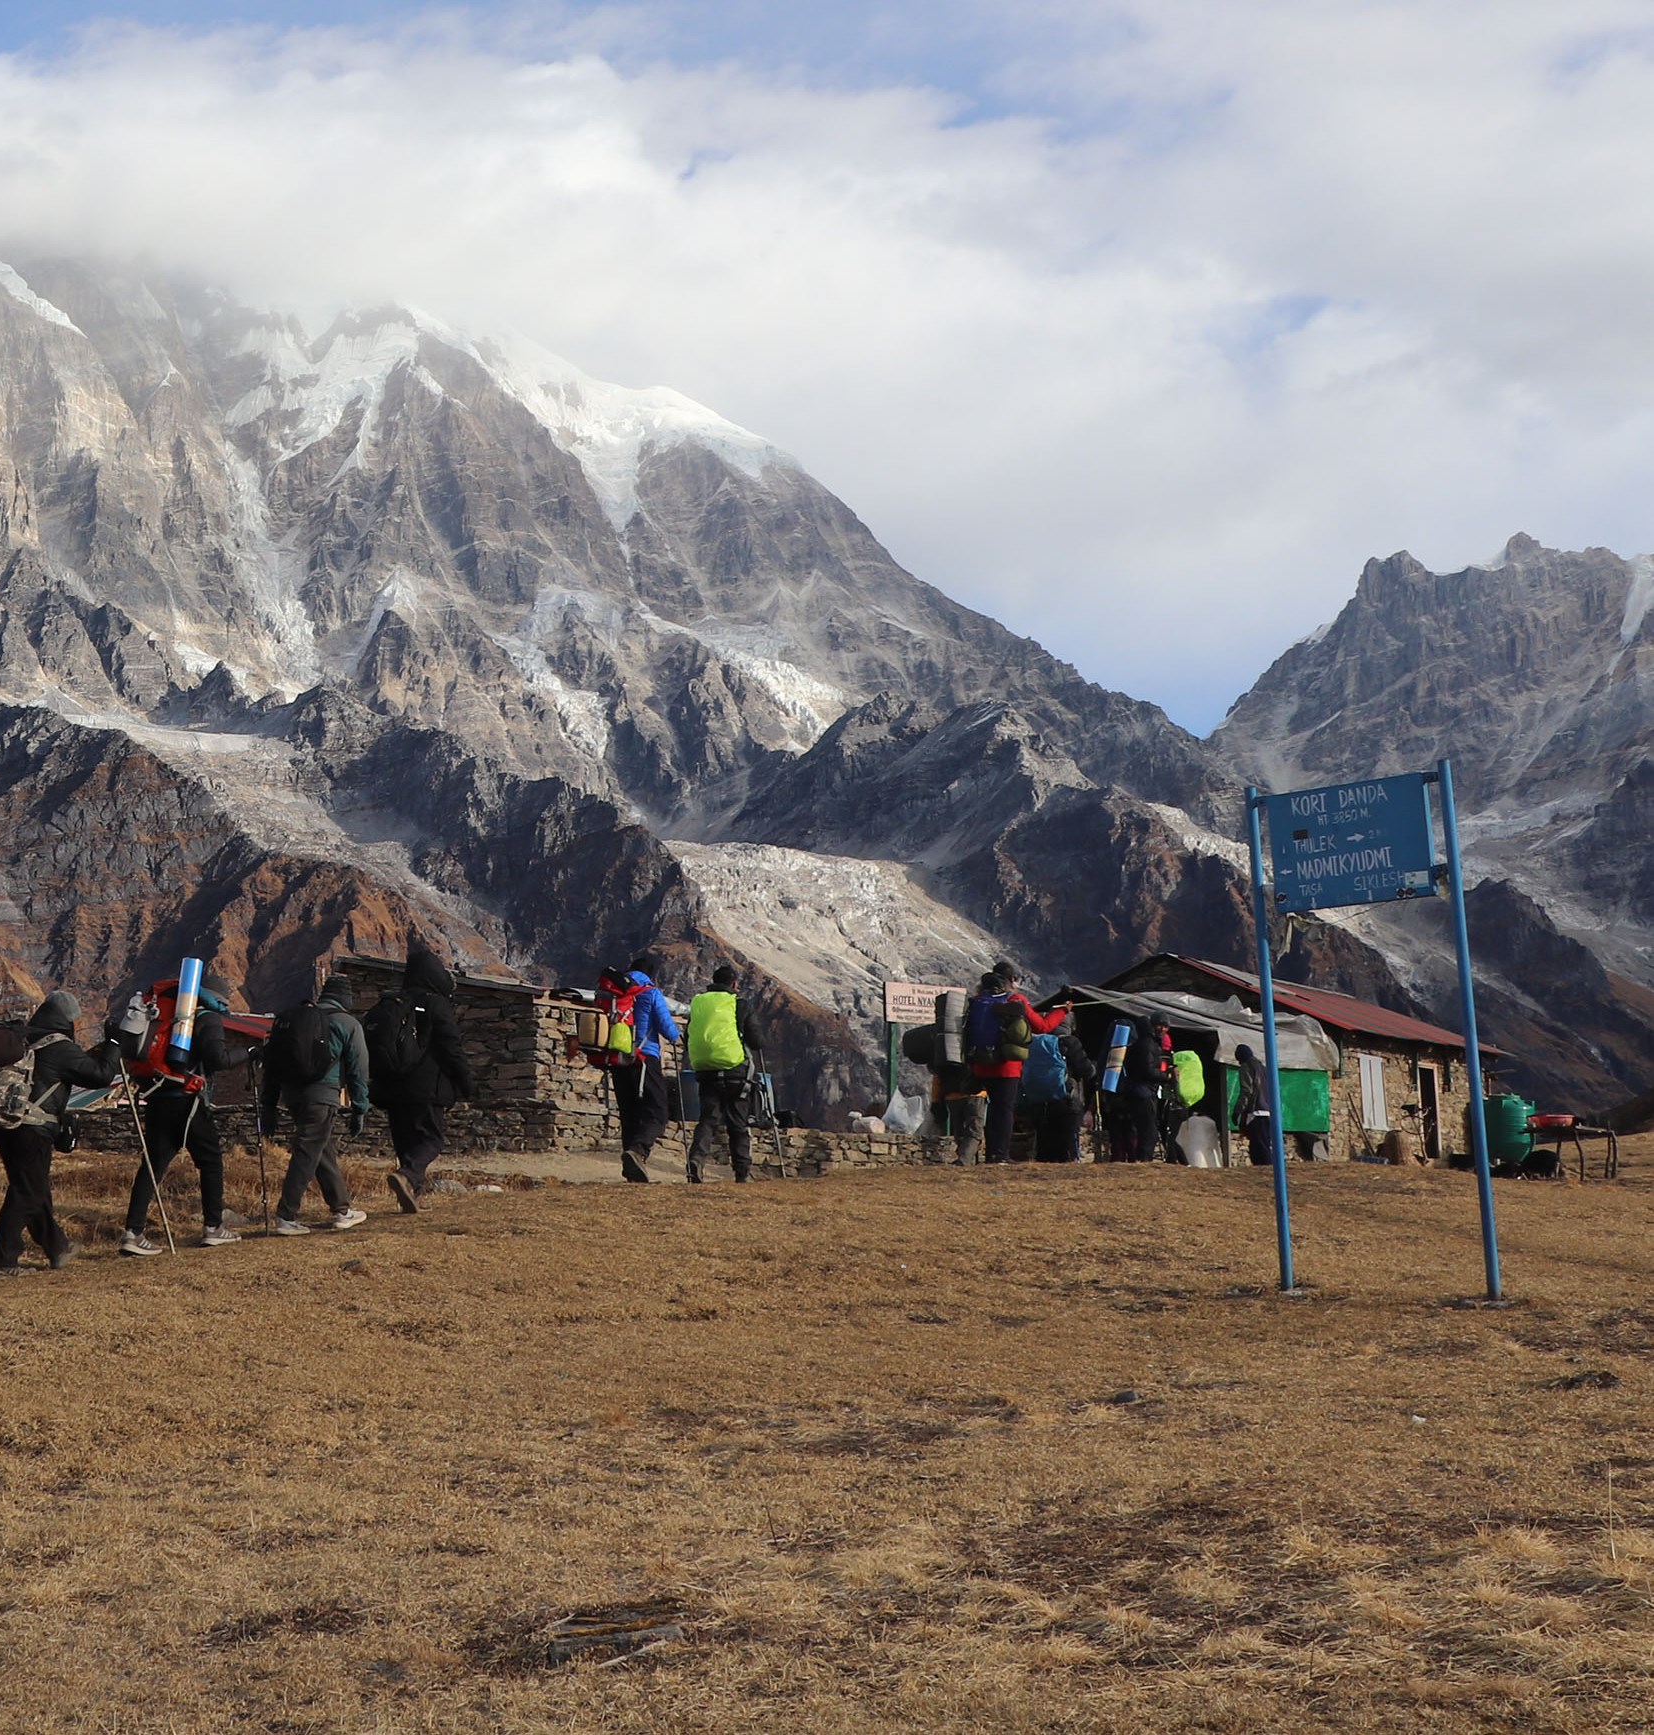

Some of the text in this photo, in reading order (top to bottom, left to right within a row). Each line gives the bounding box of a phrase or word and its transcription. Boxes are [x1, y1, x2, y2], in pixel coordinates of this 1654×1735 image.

[1290, 784, 1388, 816] KORI DANDA
[1292, 834, 1337, 855] THULEK
[1299, 883, 1323, 897] TASA
[892, 995, 916, 1005] HOTEL
